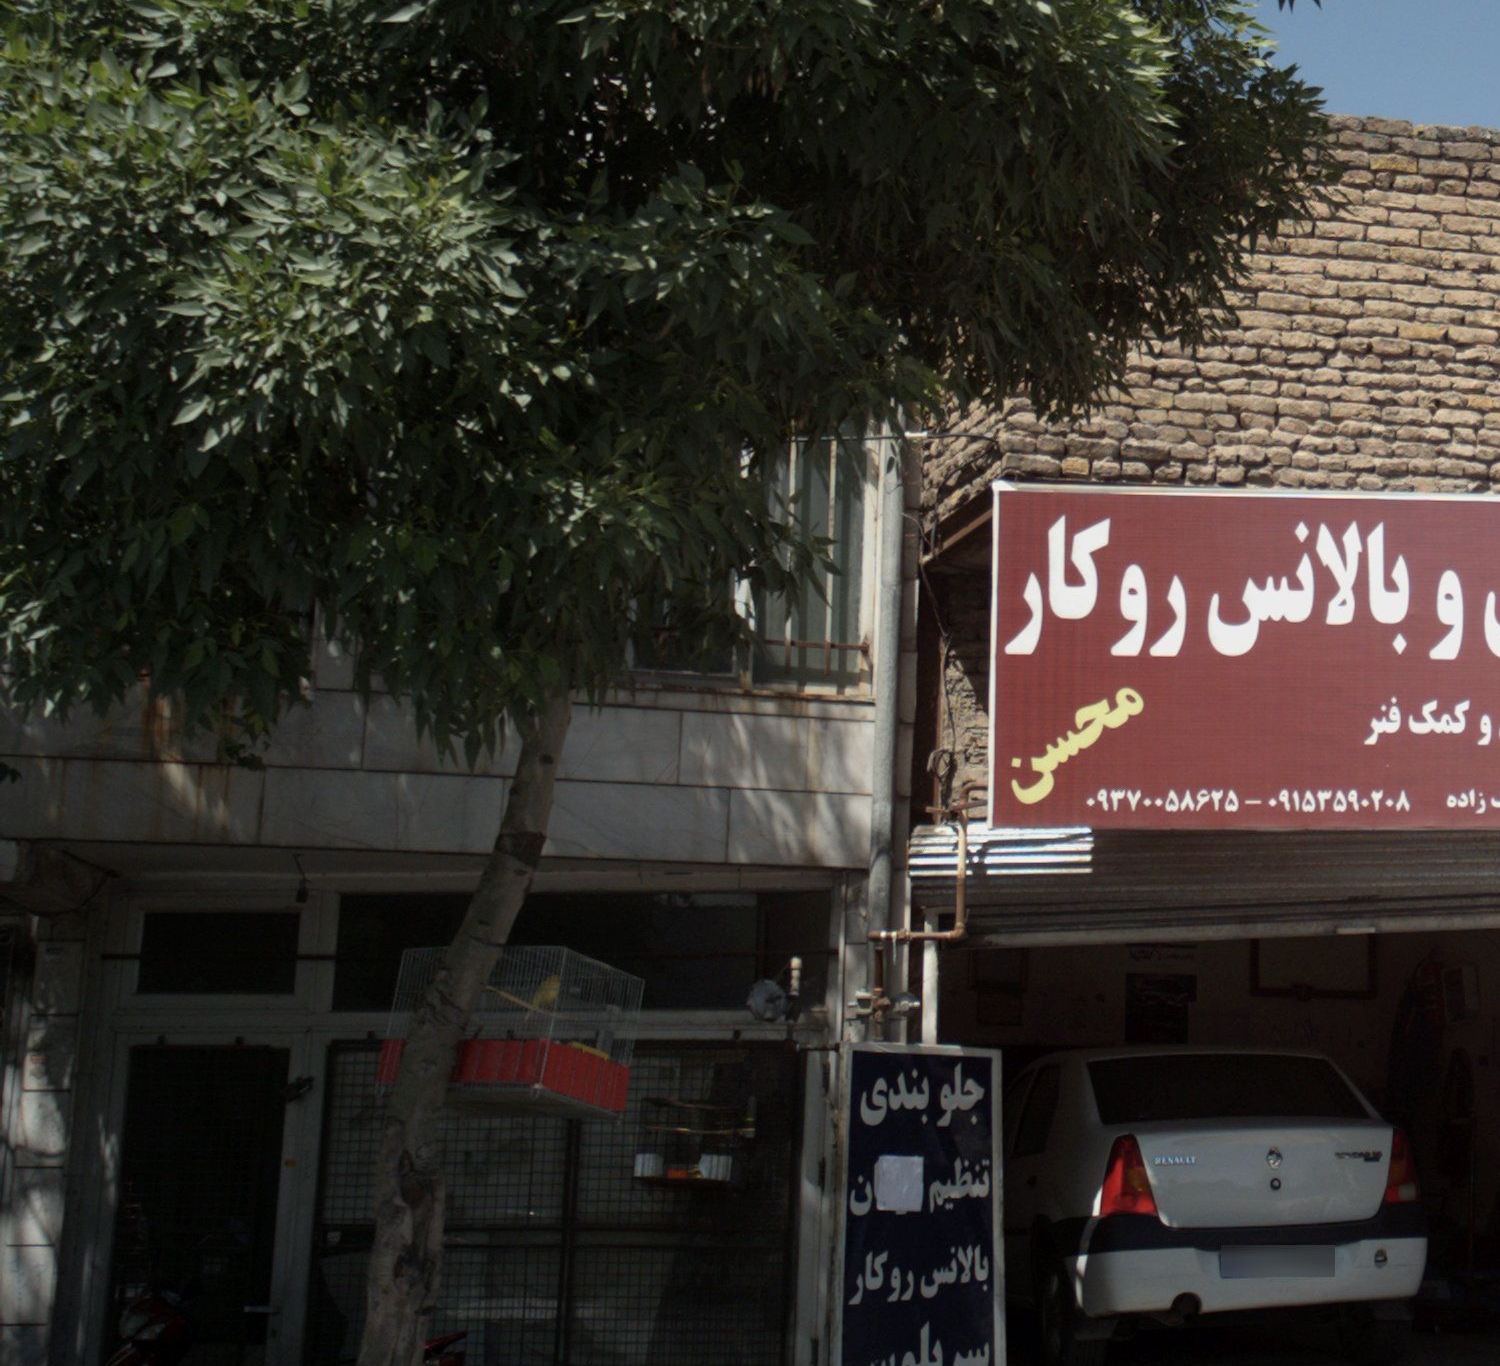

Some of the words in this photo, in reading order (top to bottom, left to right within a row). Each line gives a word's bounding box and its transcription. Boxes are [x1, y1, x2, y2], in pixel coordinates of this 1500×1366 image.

[1207, 520, 1410, 657] بالانس
[1428, 569, 1465, 661] و
[1363, 696, 1402, 746] فنر
[1407, 699, 1471, 735] کمک
[1477, 714, 1493, 746] و
[1011, 687, 1145, 805] محسن
[1086, 788, 1239, 812] ۰۹۳۷۰۰۵۸۶۲۵
[1268, 789, 1411, 812] ۰۹۱۵۳۵۹۰۲۰۸
[1446, 788, 1487, 815] زاده
[1155, 1155, 1197, 1166] RENAULT
[929, 1156, 990, 1214] تنظیم
[920, 1244, 989, 1298] بالانس
